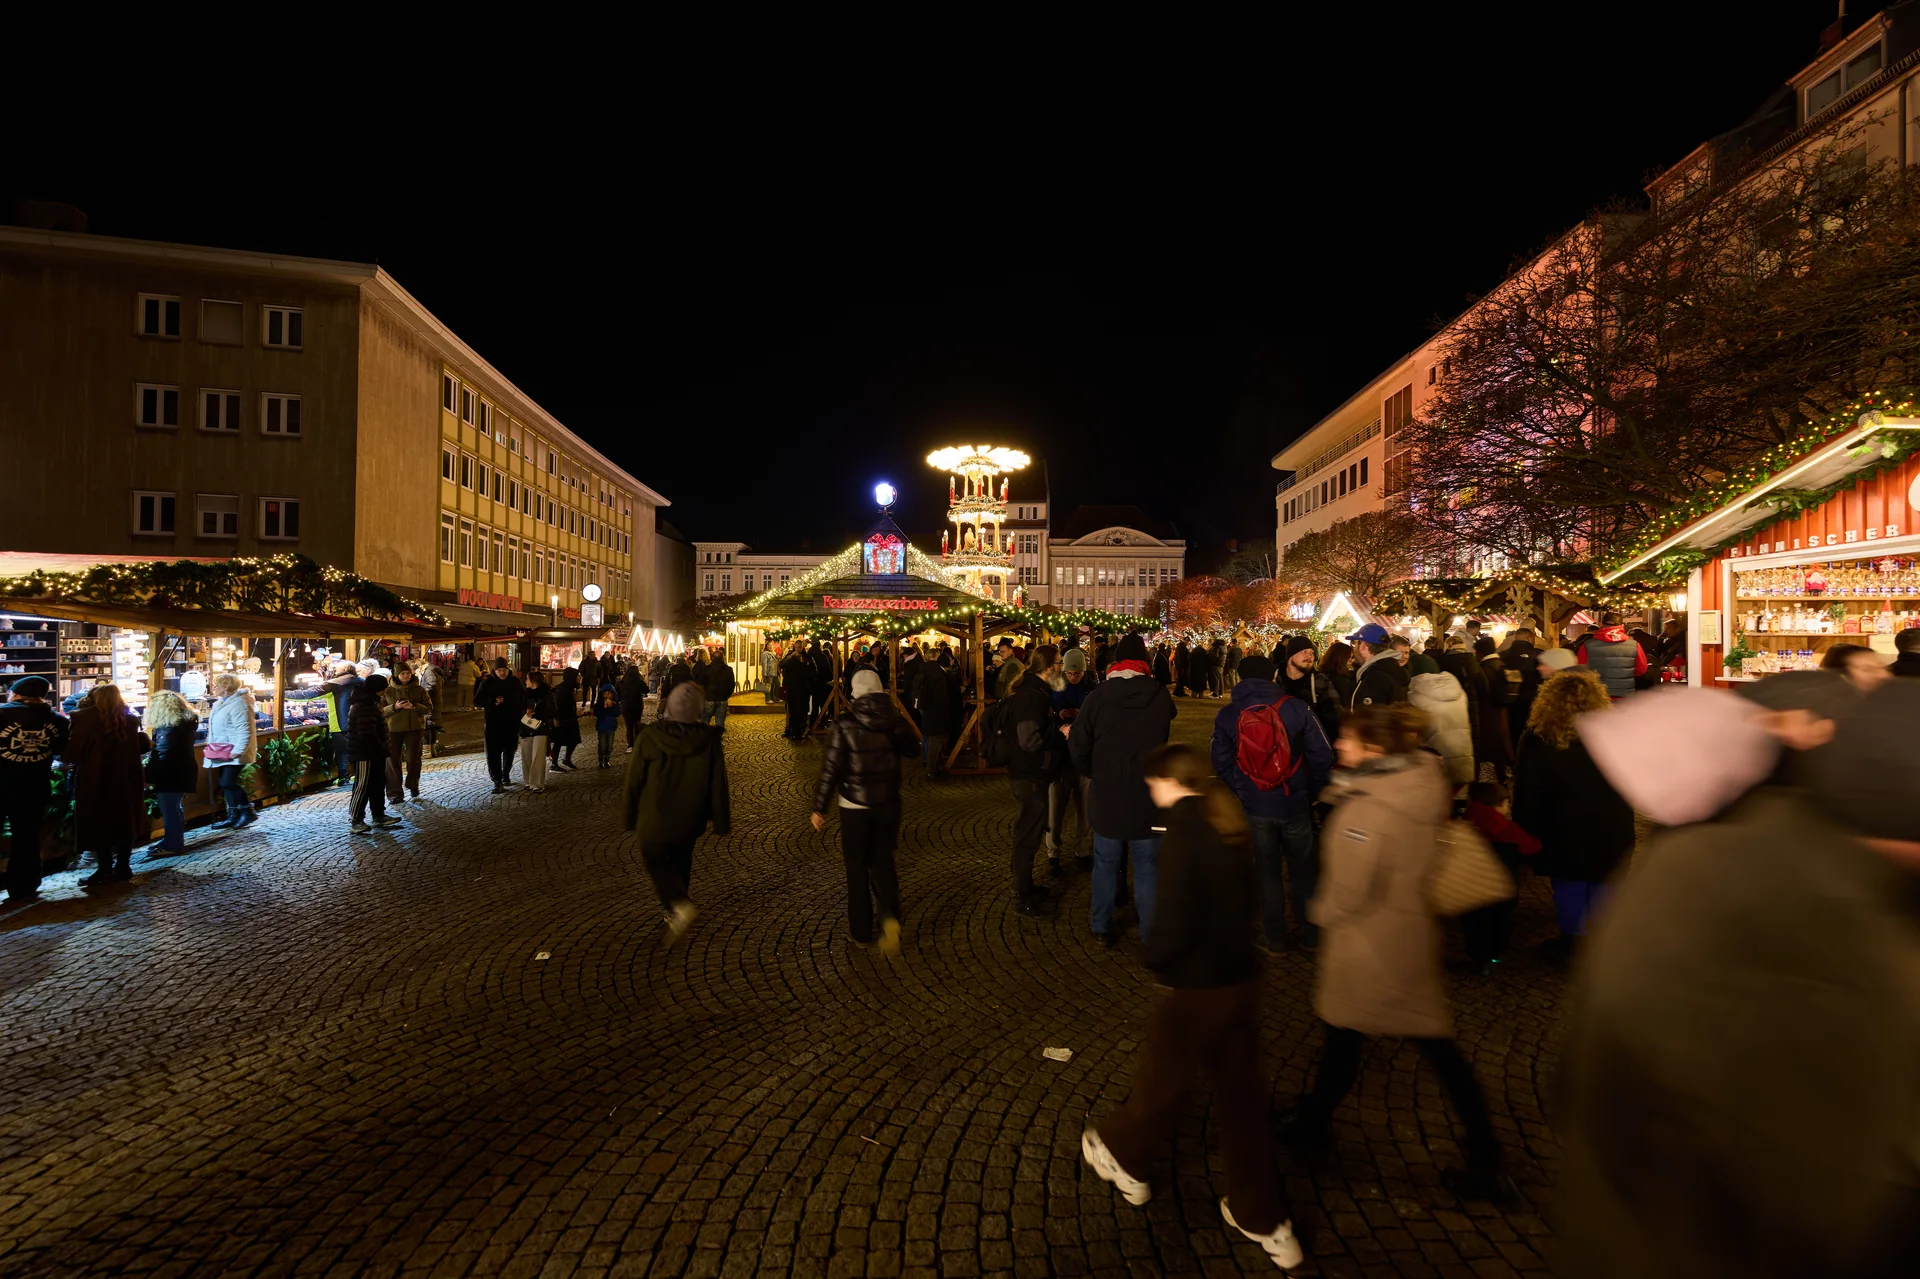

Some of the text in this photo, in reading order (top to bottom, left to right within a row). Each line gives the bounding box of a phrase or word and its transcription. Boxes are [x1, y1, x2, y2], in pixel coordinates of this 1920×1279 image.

[1730, 524, 1899, 558] FINNISCHER
[459, 588, 523, 612] WOOLWORTH
[823, 595, 939, 611] Feuerzangenbowle
